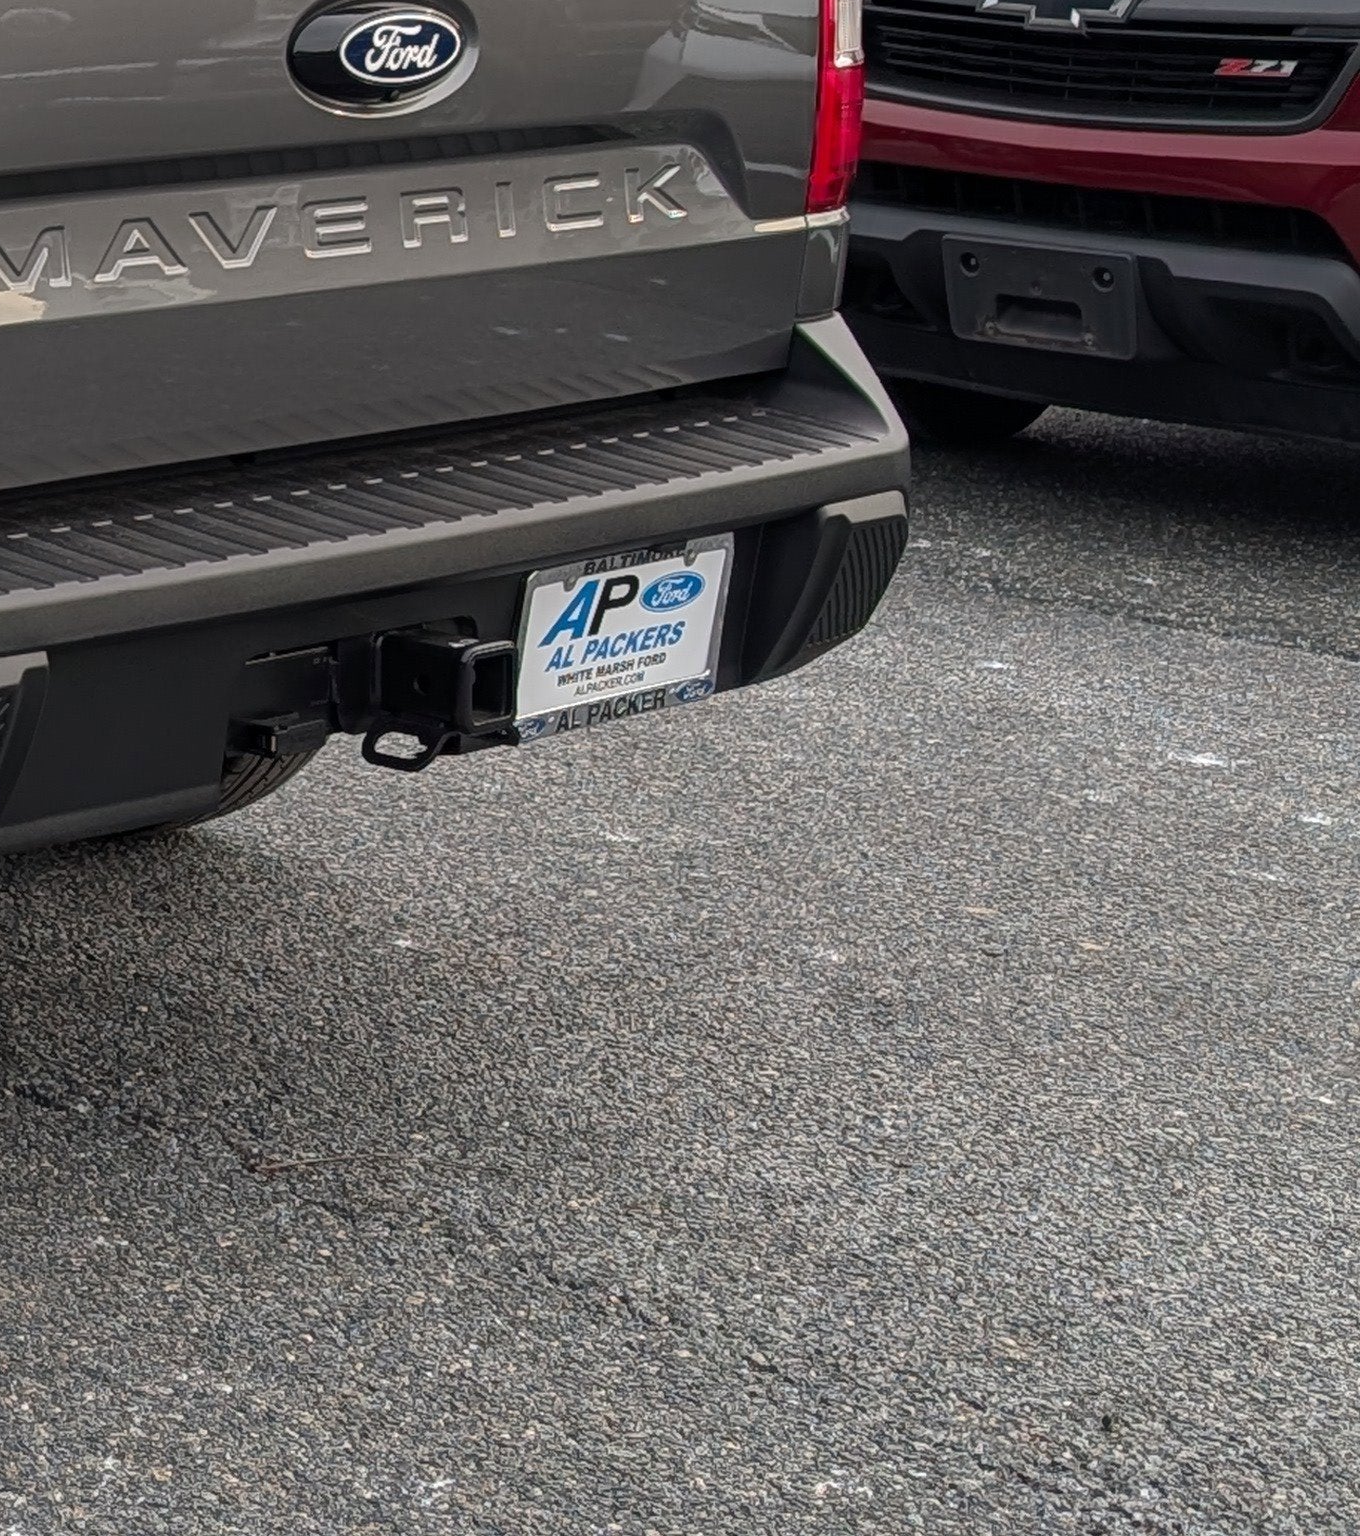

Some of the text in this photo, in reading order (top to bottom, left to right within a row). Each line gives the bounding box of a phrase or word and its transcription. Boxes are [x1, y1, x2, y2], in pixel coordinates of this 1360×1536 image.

[363, 24, 440, 74] Ford
[1214, 57, 1299, 78] Z71
[538, 574, 640, 648] AP
[651, 576, 691, 607] Ford
[545, 620, 687, 672] AL PACKERS
[557, 652, 667, 687] WHITE MARSH FORD
[573, 670, 646, 698] ALPACKER.COM
[555, 688, 667, 734] AL PACKER
